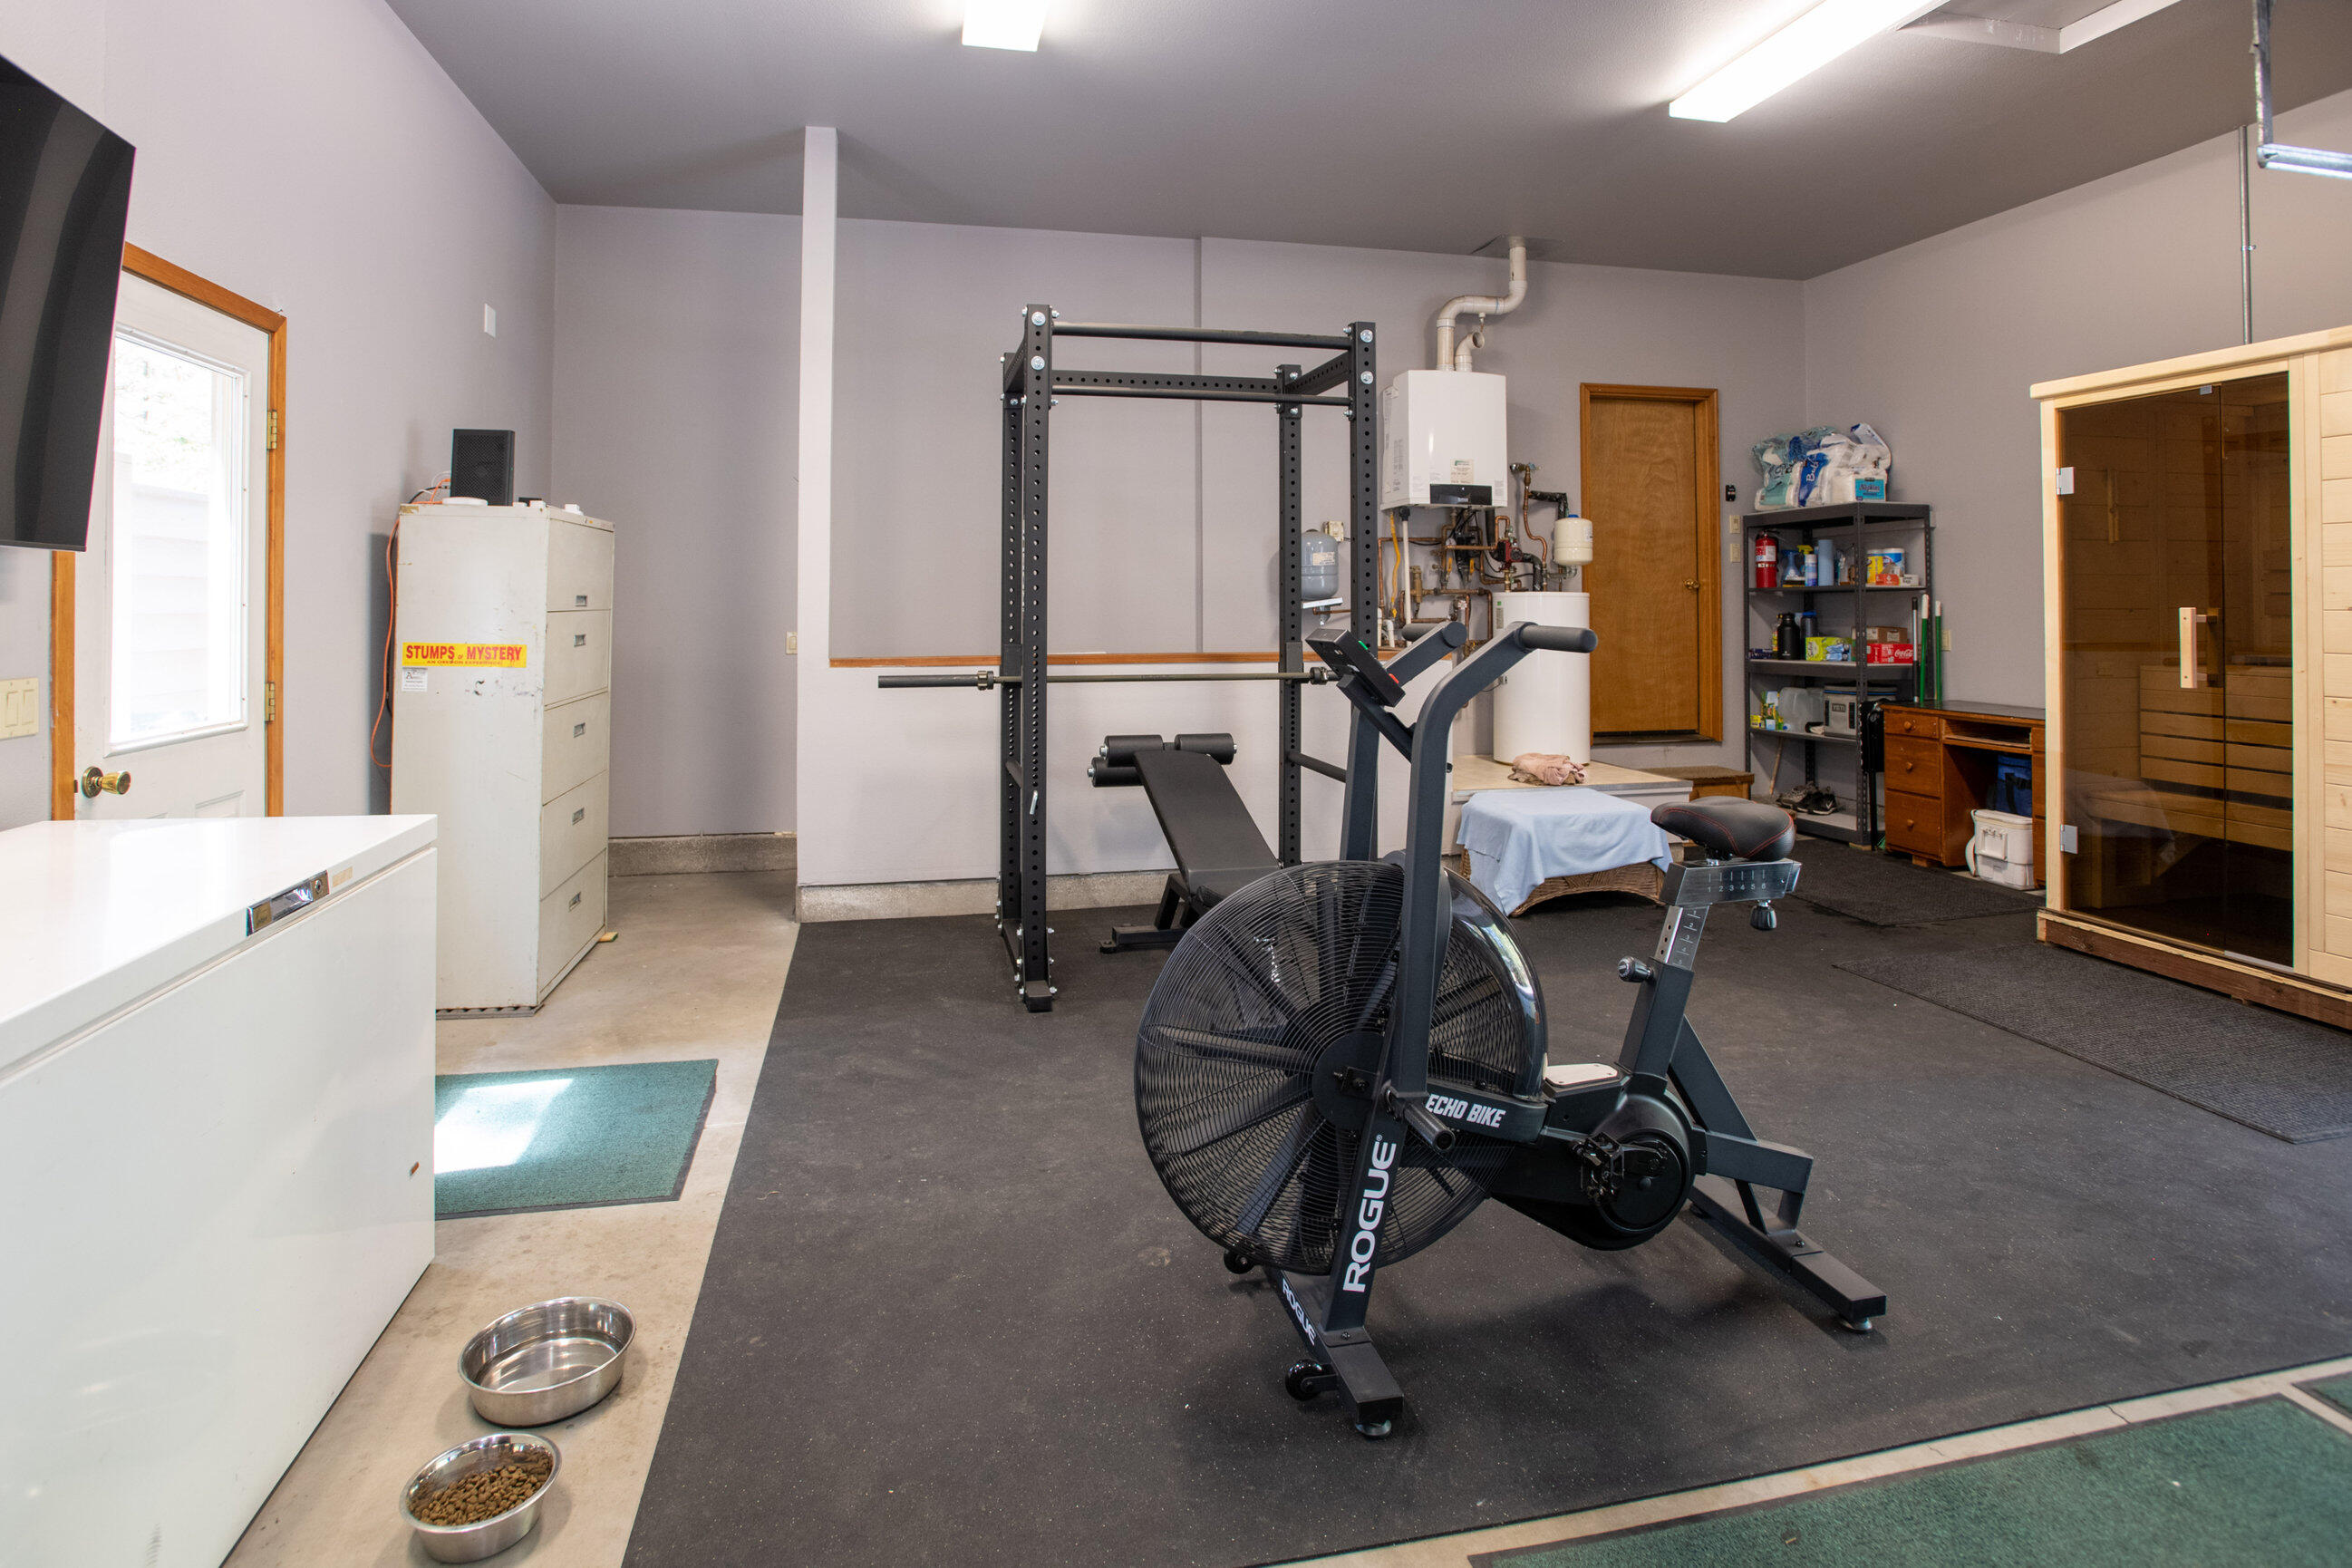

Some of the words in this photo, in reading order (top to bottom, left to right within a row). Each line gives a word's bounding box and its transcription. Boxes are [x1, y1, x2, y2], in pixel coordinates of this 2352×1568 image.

[405, 644, 455, 660] STUMPS
[467, 645, 523, 661] MYSTERY
[1425, 1093, 1468, 1119] ECHO
[1466, 1103, 1506, 1128] BIKE
[1282, 1278, 1317, 1346] ROGUE
